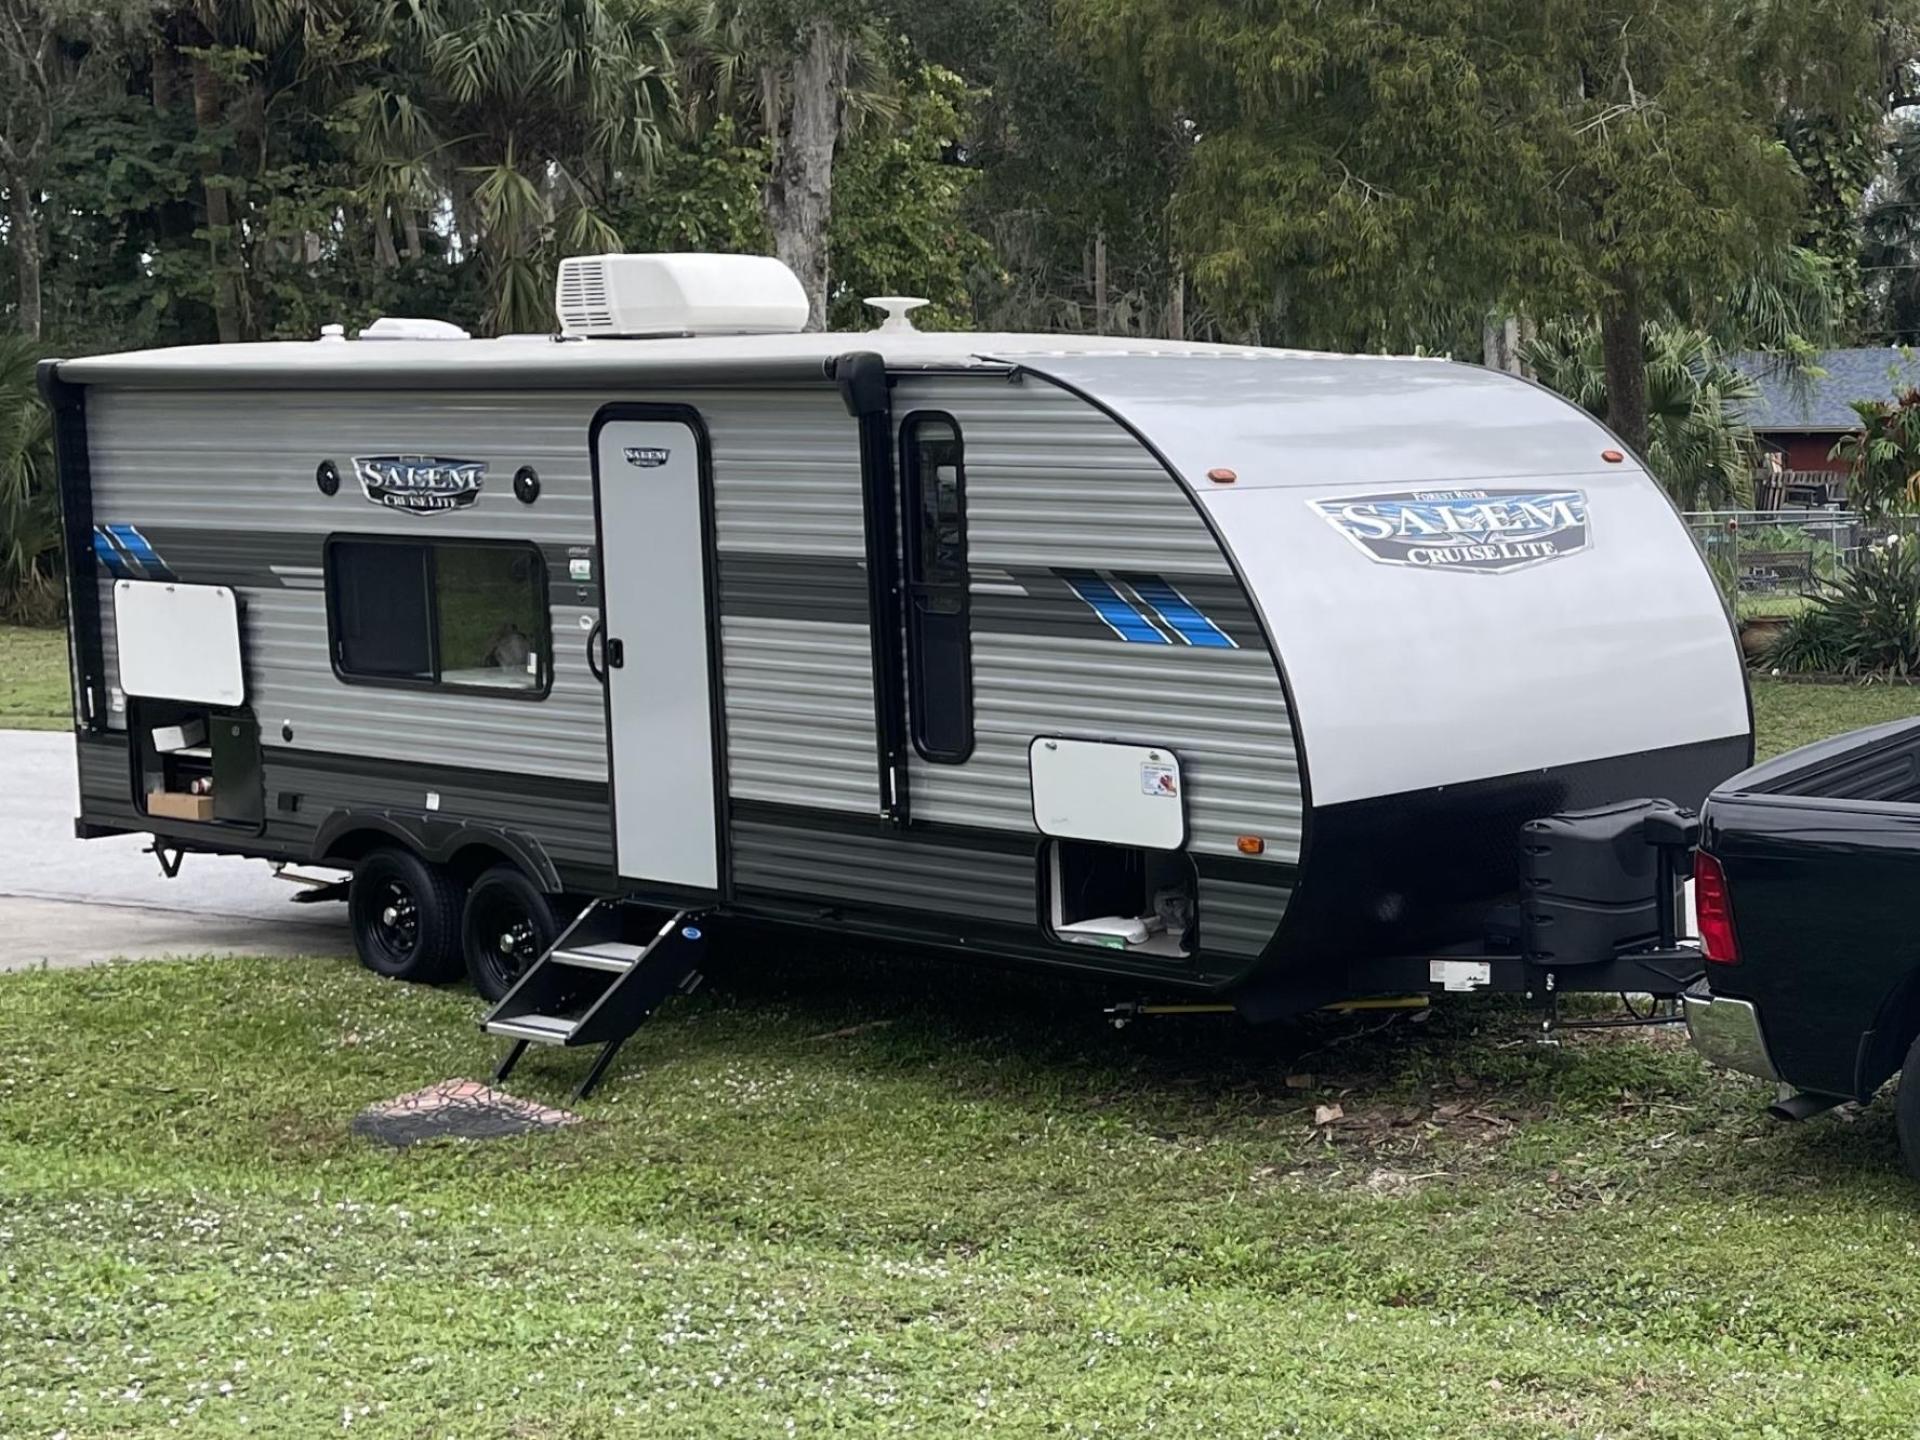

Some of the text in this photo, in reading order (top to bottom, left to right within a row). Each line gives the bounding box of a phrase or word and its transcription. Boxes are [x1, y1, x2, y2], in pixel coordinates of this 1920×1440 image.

[624, 449, 667, 460] SALEM
[364, 462, 478, 489] SALEM
[1341, 499, 1584, 540] SALEM
